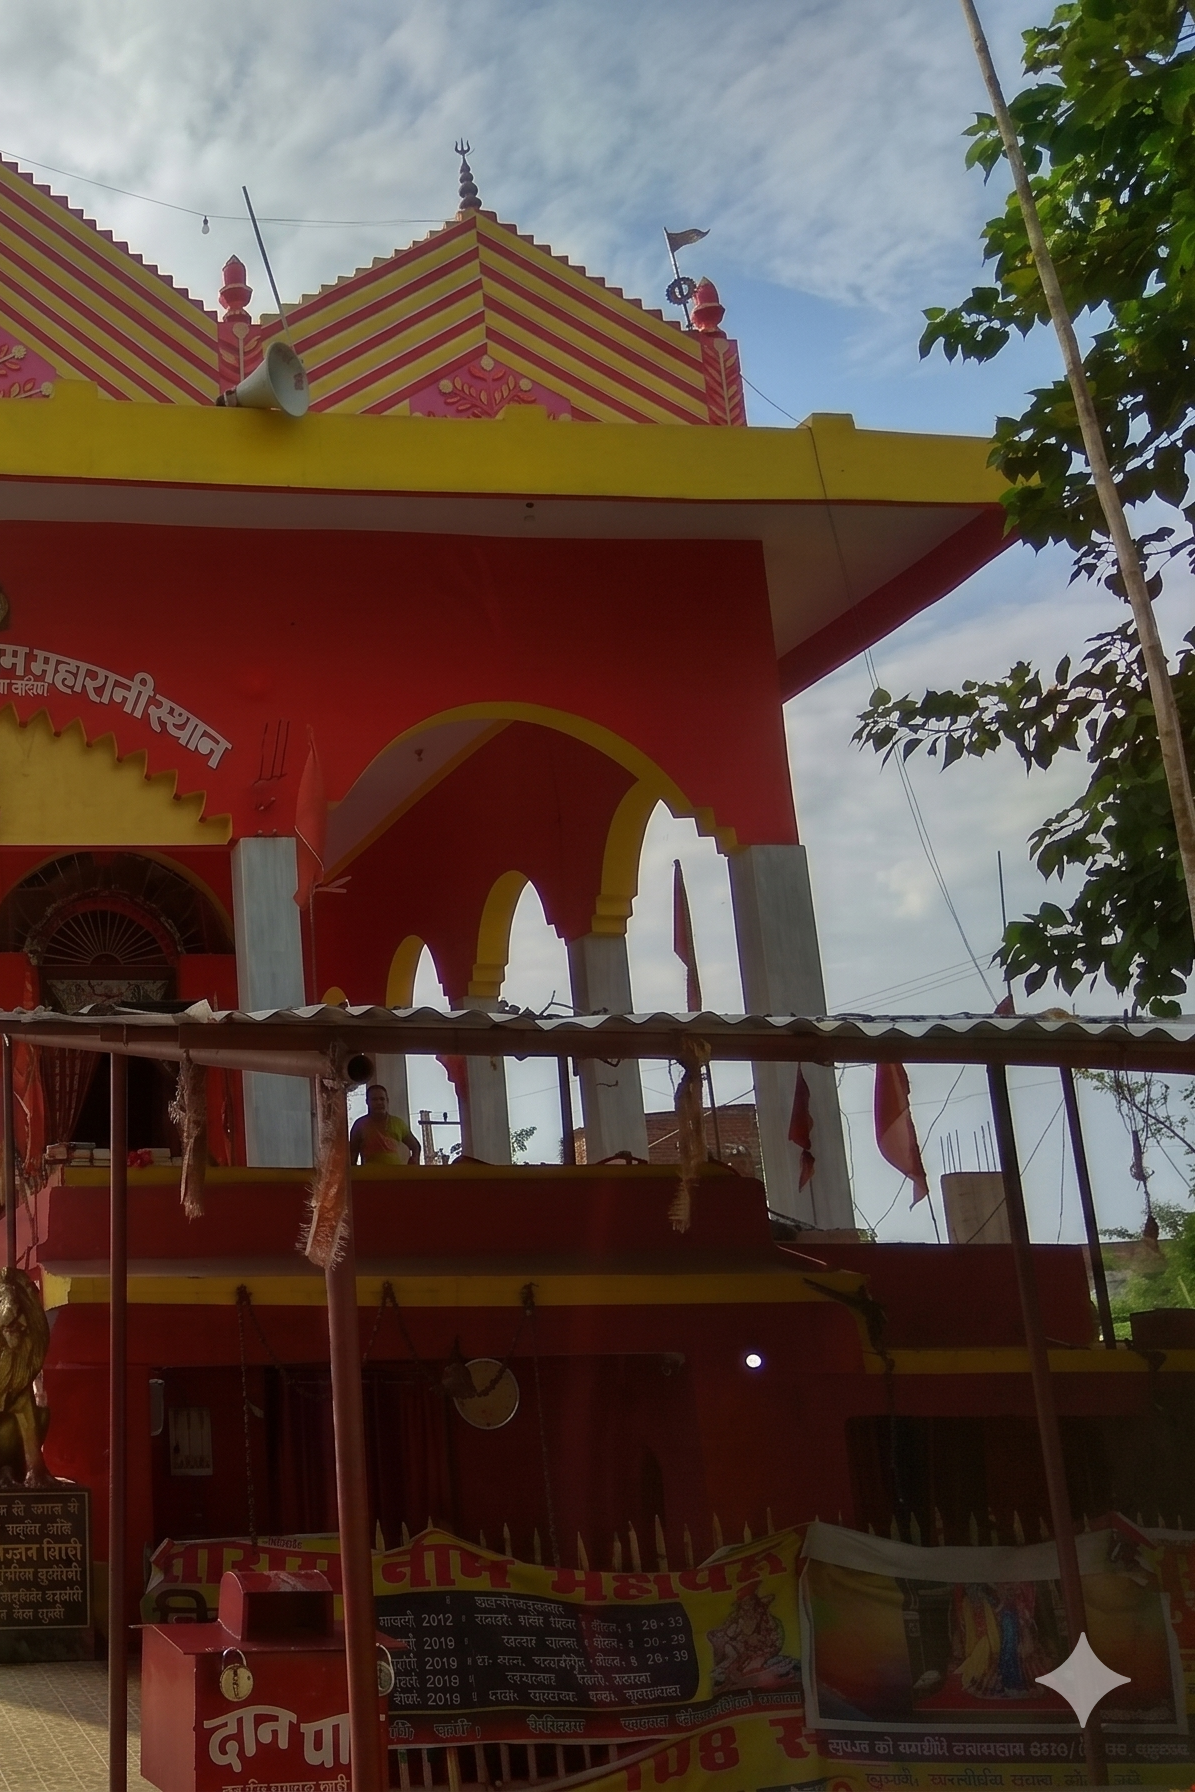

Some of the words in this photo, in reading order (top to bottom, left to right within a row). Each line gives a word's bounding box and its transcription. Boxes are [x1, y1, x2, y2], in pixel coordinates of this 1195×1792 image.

[30, 650, 158, 719] महारानी
[147, 694, 232, 770] स्थान
[421, 1613, 454, 1627] 2012
[423, 1636, 455, 1650] 2019
[425, 1657, 458, 1670] 2019
[426, 1675, 459, 1688] 2019
[427, 1692, 461, 1706] 2019
[204, 1705, 297, 1773] दान
[300, 1713, 350, 1768] पा
